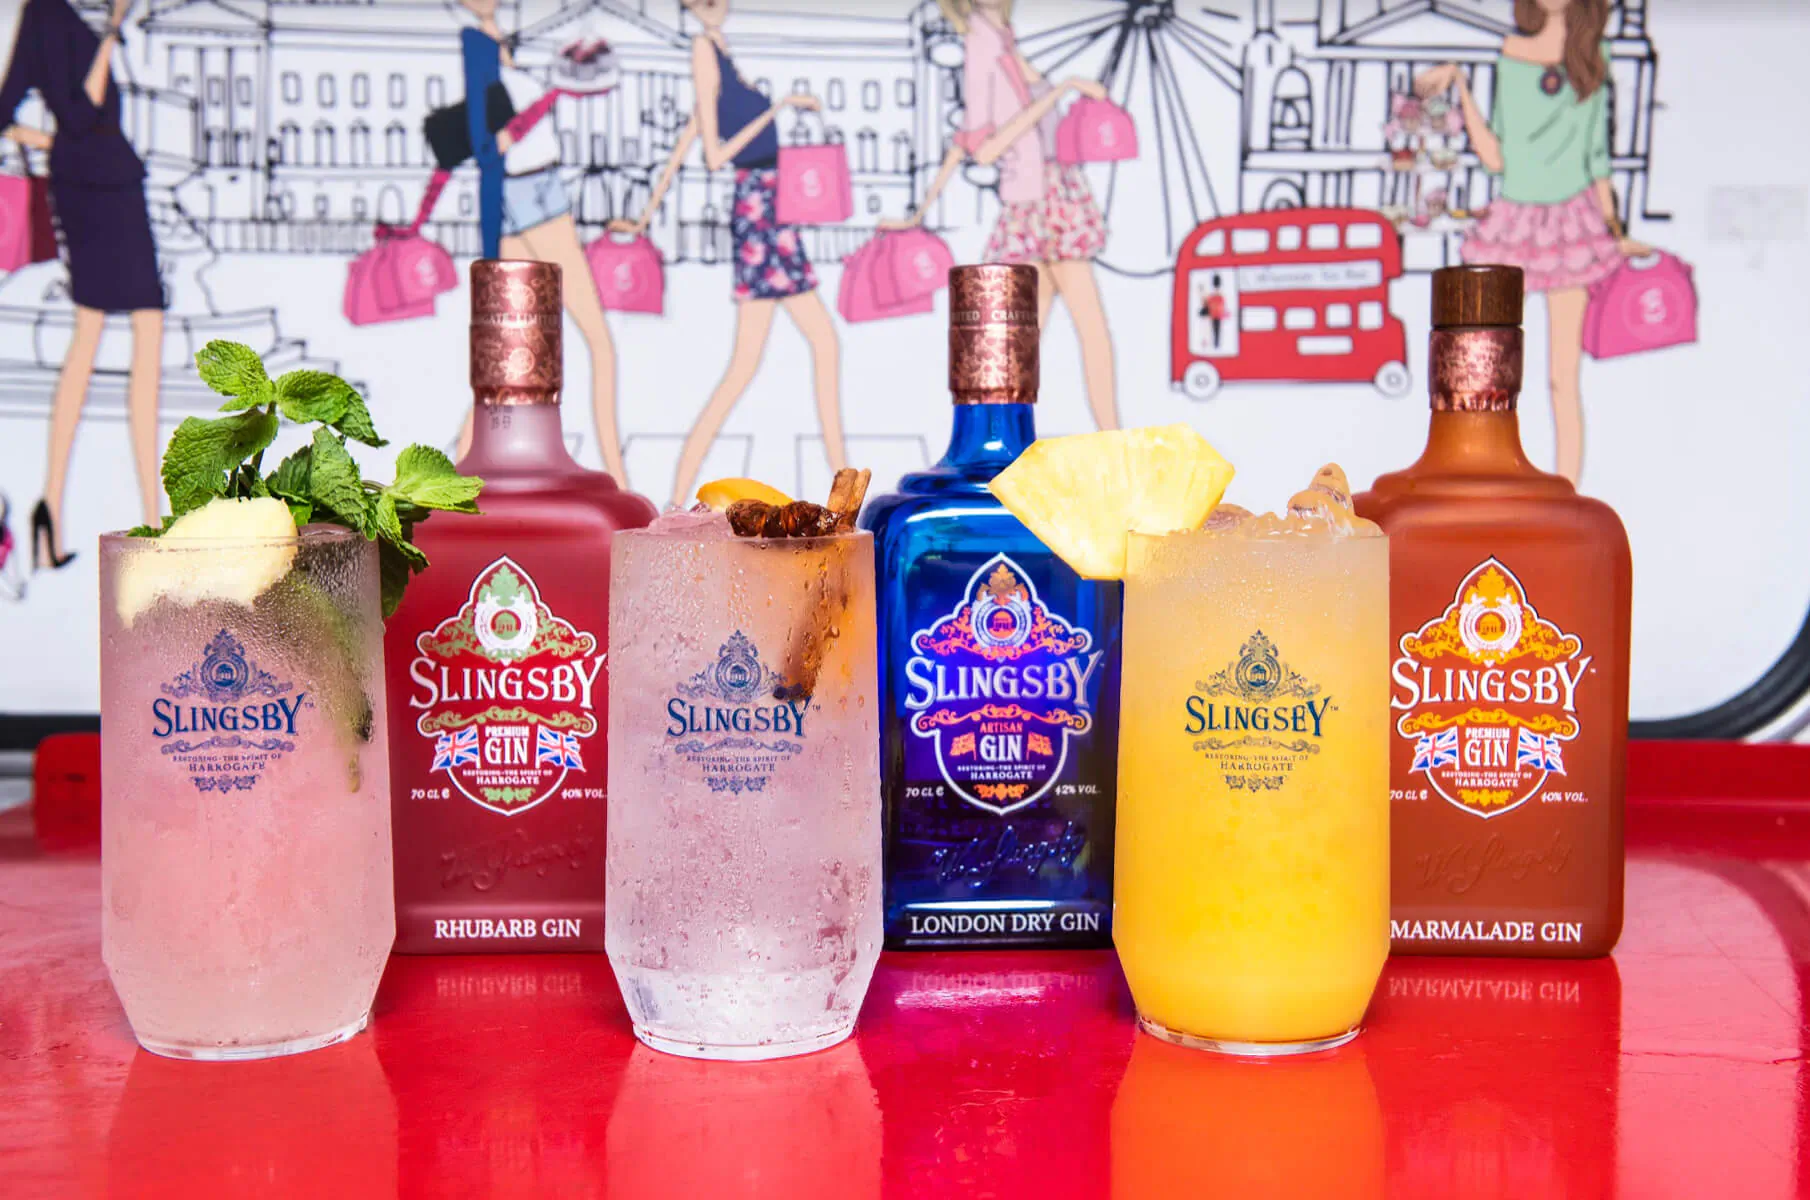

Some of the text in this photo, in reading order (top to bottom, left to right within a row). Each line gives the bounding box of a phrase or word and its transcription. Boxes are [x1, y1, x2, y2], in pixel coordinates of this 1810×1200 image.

[409, 653, 606, 710] SLINGSBY
[904, 650, 1104, 709] SLINGSBY
[1390, 655, 1592, 712] SLINGSBY
[152, 692, 305, 737] SLINGSBY
[667, 695, 812, 737] SLINGSBY
[485, 725, 530, 737] PREMIUM
[980, 722, 1023, 733] ARTISAN
[1465, 727, 1511, 739] PREMIUM
[484, 737, 529, 765] GIN
[979, 733, 1023, 762] GIN
[1464, 739, 1510, 767] GIN
[189, 762, 265, 772] HARROGATE
[702, 763, 776, 773] HARROGATE
[1220, 761, 1294, 772] HARROGATE
[476, 775, 540, 785] HARROGATE
[970, 771, 1033, 780] HARROGATE
[1455, 778, 1519, 788] HARROGATE
[411, 788, 426, 800] 70
[905, 787, 920, 799] 70
[1389, 789, 1404, 801] 70
[434, 919, 582, 938] RHUBARB GIN
[910, 912, 1100, 934] LONDON DRY GIN
[1390, 919, 1583, 942] MARMALADE GIN
